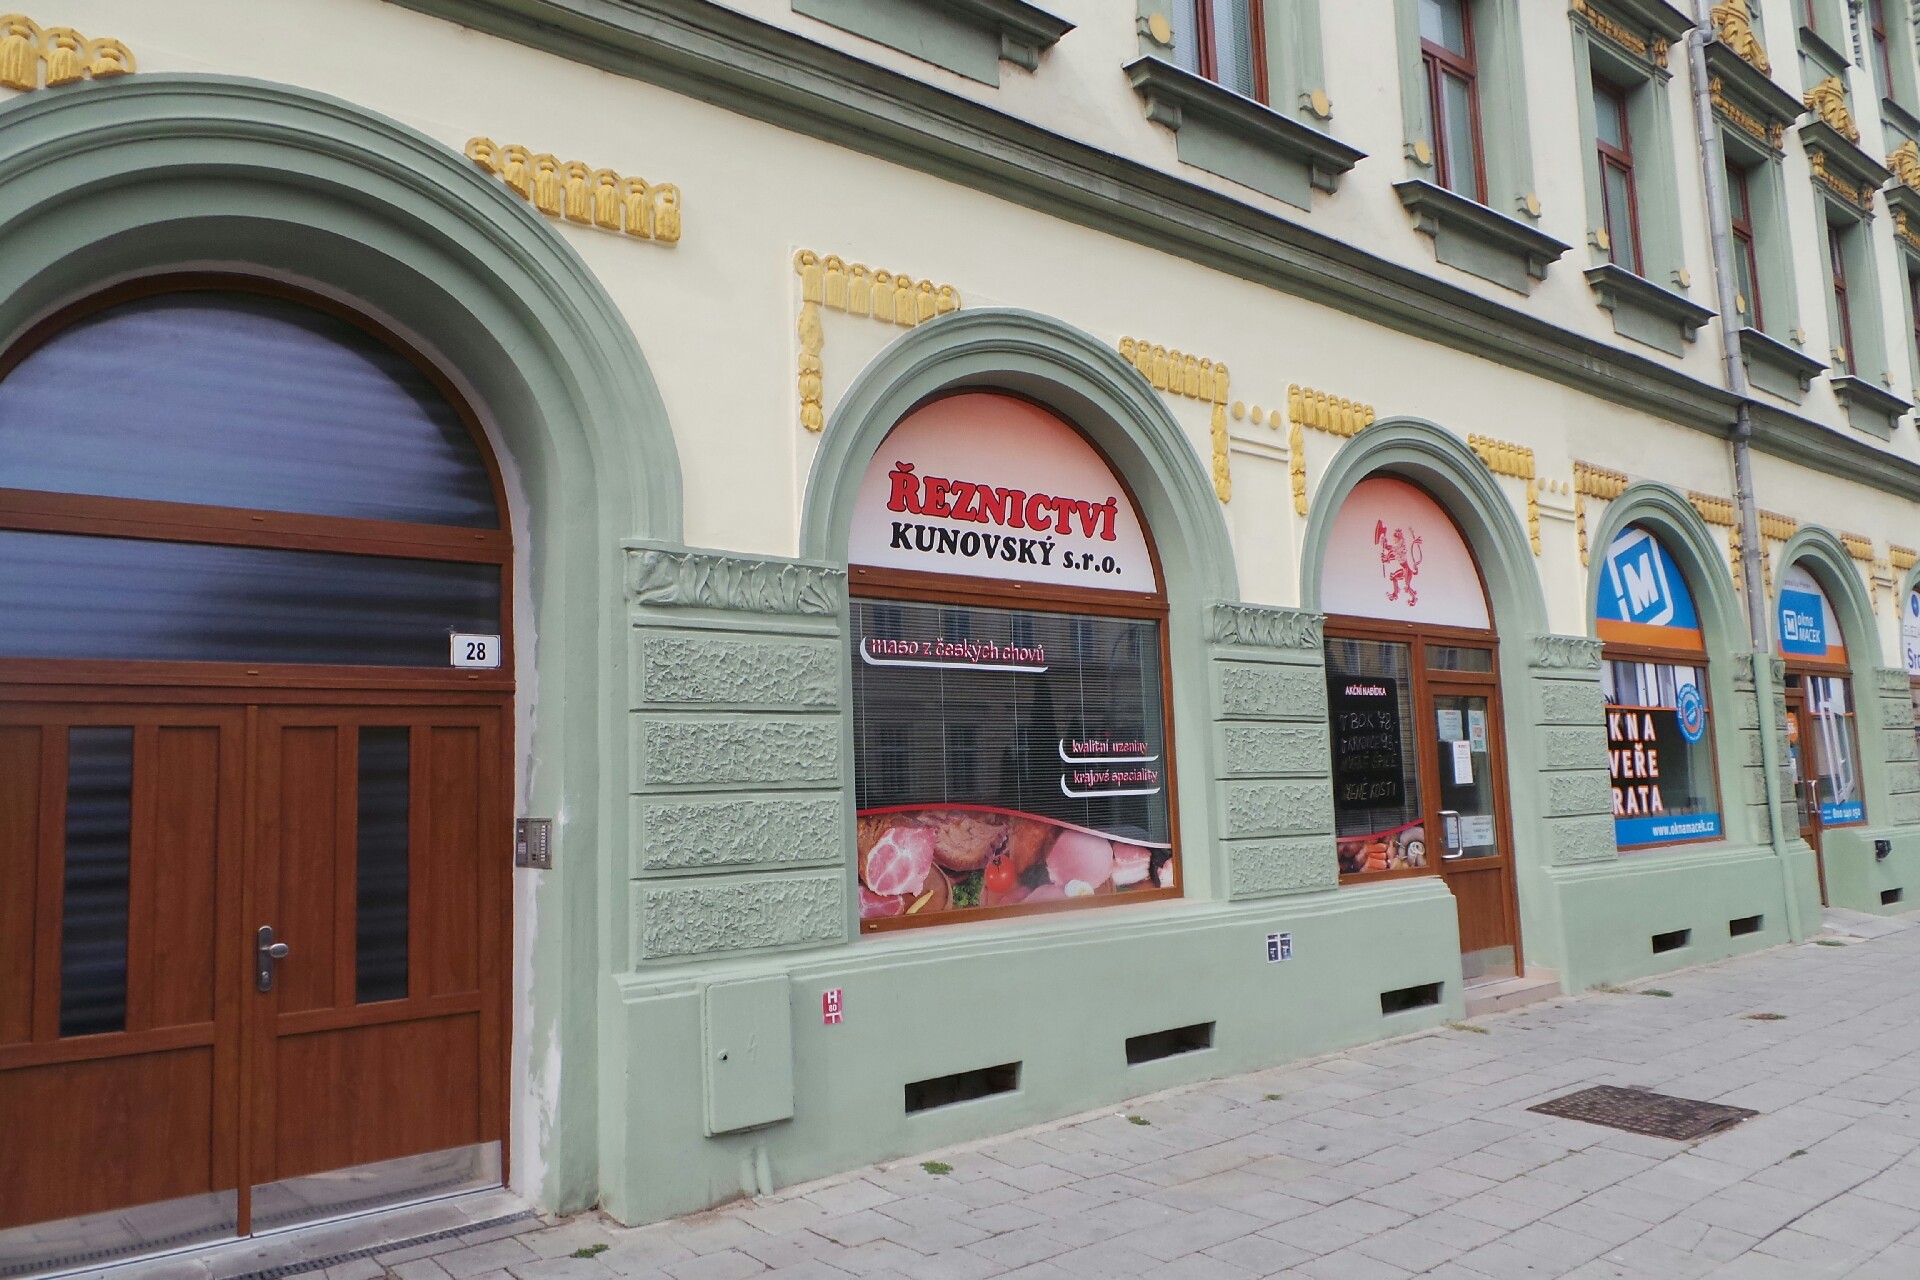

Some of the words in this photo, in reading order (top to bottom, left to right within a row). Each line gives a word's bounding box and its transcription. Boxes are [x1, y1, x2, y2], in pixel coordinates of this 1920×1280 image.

[887, 461, 1118, 541] ŘEZNICTVÍ
[890, 522, 1055, 565] KUNOVSKÝ
[1063, 551, 1121, 574] s.r.o.
[1622, 552, 1660, 616] M
[466, 642, 486, 661] 28
[871, 638, 919, 655] maso
[922, 642, 932, 656] z
[935, 637, 999, 663] českých
[1002, 642, 1045, 662] chovů
[1345, 684, 1362, 696] AKČNÍ
[1363, 685, 1387, 696] NABÍDKA
[1609, 713, 1656, 741] KNA
[1072, 739, 1109, 753] kvalitní
[1112, 740, 1148, 754] uzeniny
[1608, 742, 1659, 778] VEŘE
[1074, 769, 1109, 786] krajové
[1111, 768, 1158, 786] speciality
[1612, 785, 1664, 816] RATA
[1652, 819, 1715, 837] www.oknamacek.cz
[828, 990, 837, 1003] H
